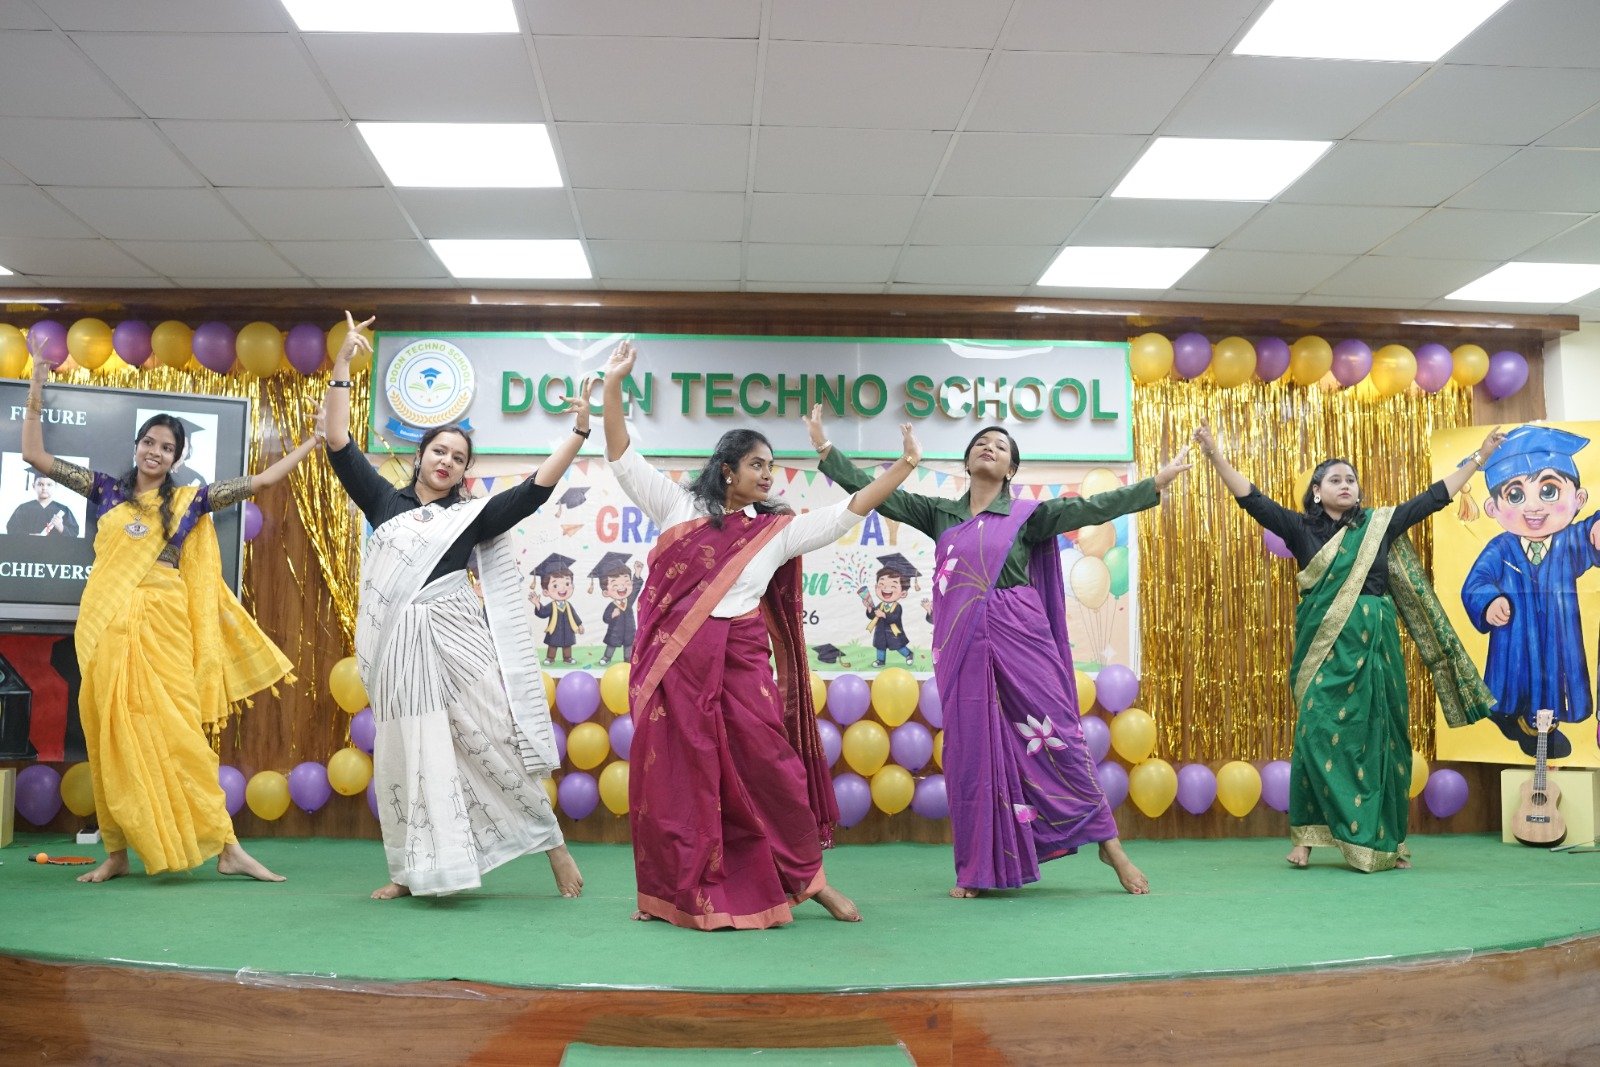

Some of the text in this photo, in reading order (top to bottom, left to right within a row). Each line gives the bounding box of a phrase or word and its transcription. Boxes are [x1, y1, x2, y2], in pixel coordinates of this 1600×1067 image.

[389, 342, 471, 385] DOON TECHNO SCHOOL
[671, 371, 888, 417] TECHNO
[904, 374, 1119, 420] SCHOOL
